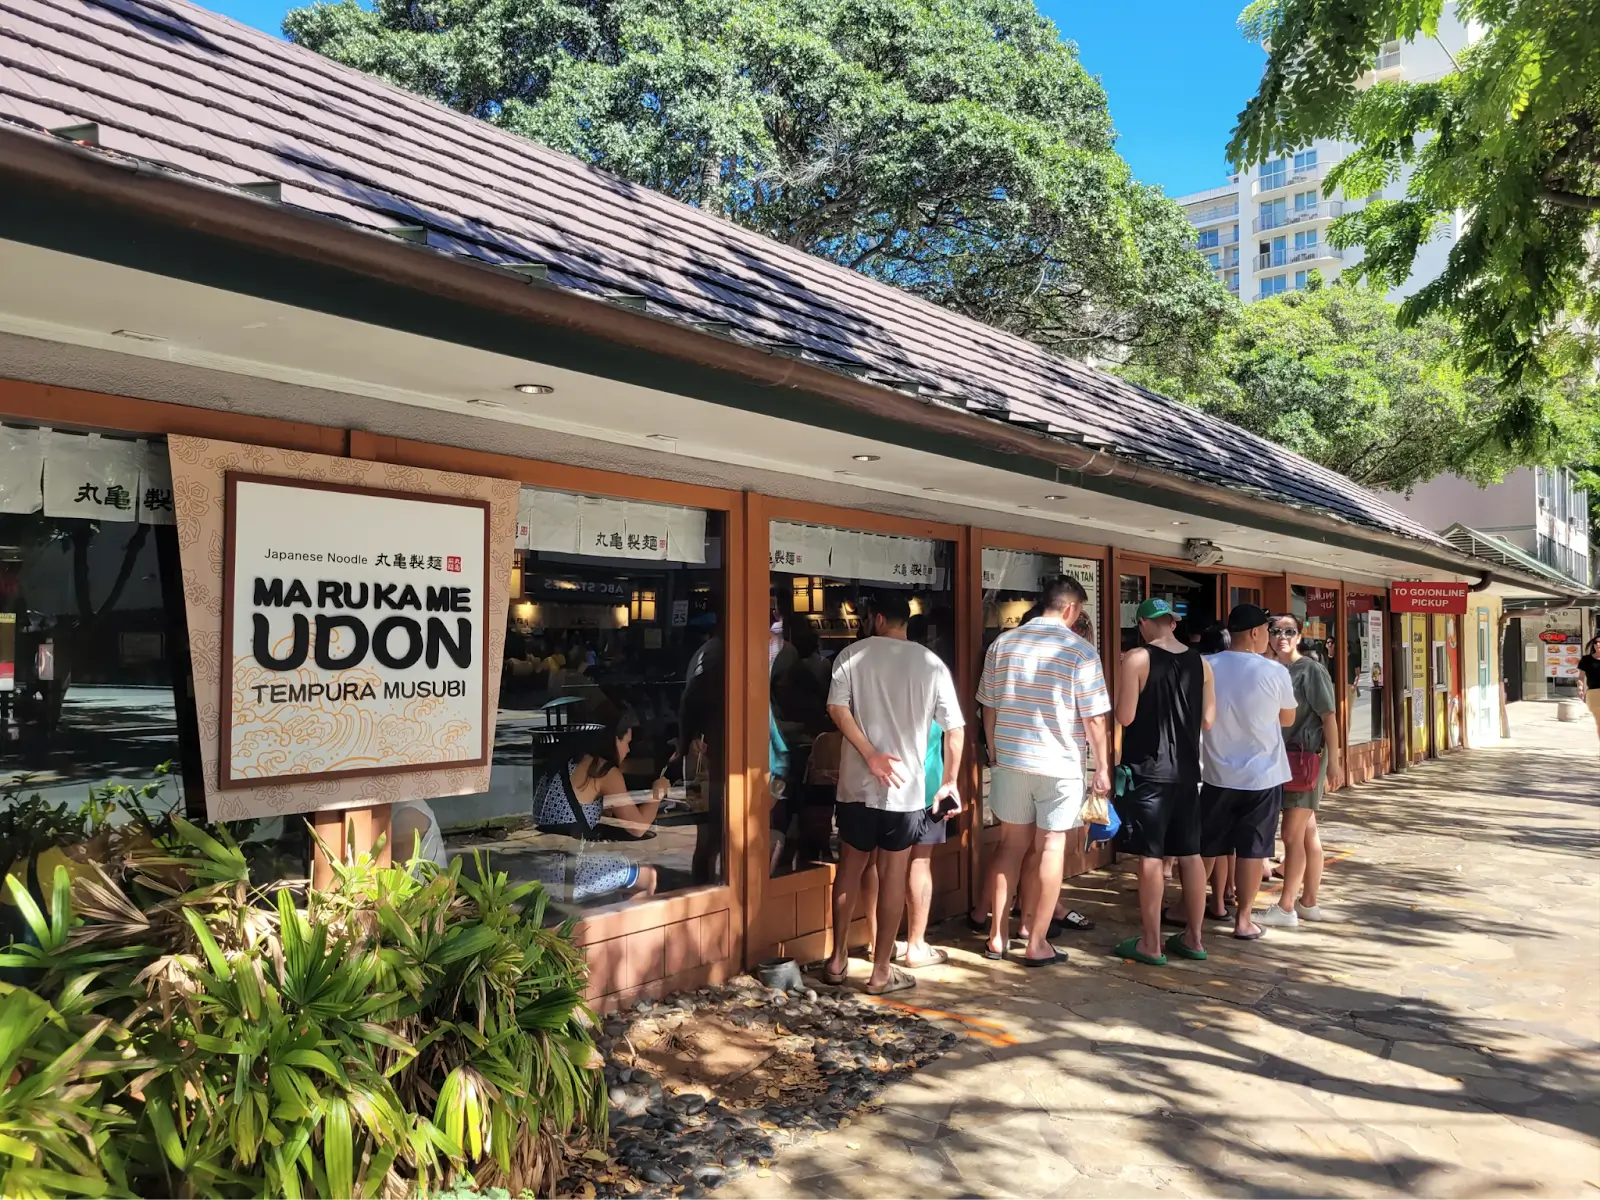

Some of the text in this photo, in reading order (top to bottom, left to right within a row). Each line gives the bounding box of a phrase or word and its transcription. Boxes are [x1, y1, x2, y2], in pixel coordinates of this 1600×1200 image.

[264, 548, 368, 565] Japanese Noodle
[1080, 571, 1094, 582] TAN
[252, 576, 472, 613] MARUKAME
[1394, 588, 1466, 598] TO GO/ONLINE
[1411, 598, 1449, 608] PICKUP
[252, 612, 472, 672] UDON
[251, 680, 466, 704] TEMPURA MUSUBI
